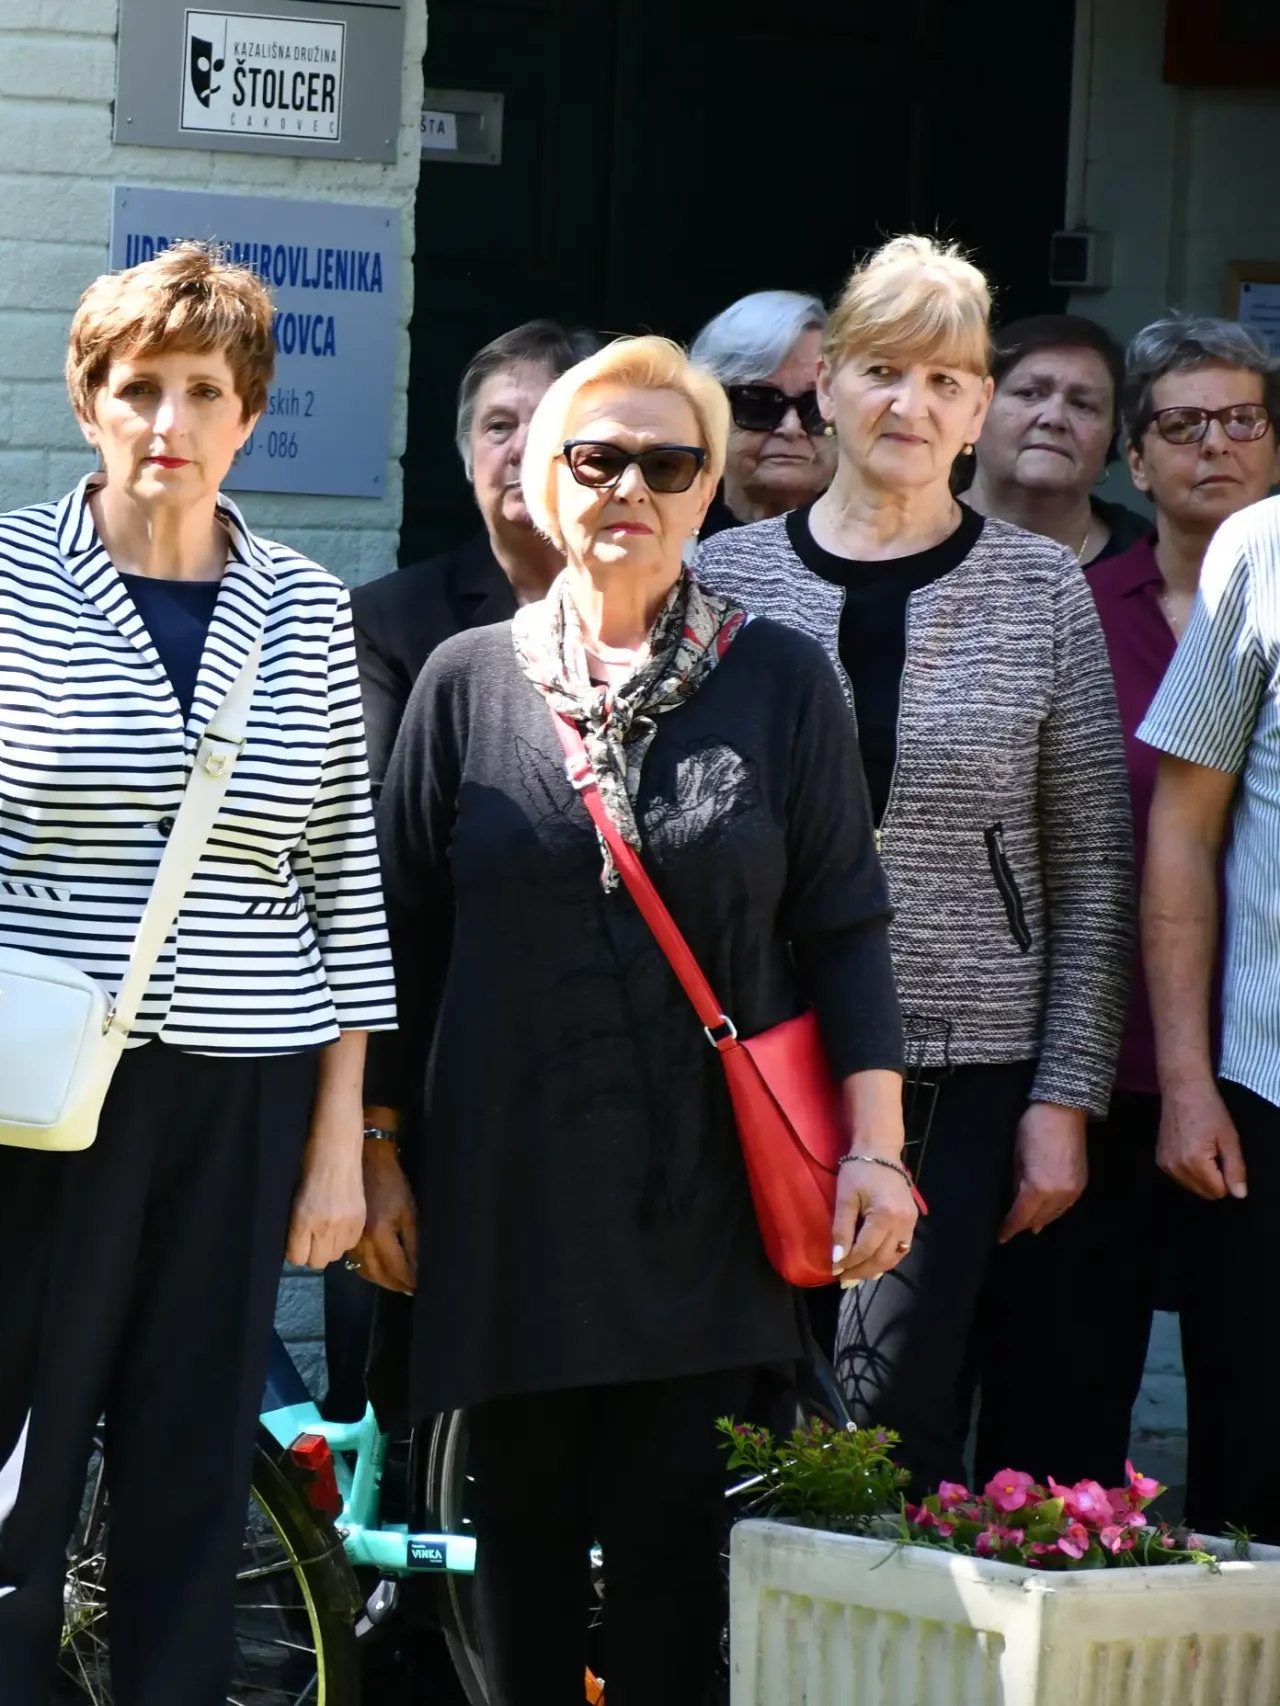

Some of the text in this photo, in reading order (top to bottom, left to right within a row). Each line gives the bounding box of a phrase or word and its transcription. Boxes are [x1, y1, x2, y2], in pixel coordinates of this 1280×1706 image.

[233, 41, 337, 64] KAZALIŠNA DRUŽINA
[232, 58, 336, 113] ŠTOLCER
[230, 112, 335, 133] ČAKOVEC
[421, 115, 446, 134] ŠTA
[272, 312, 336, 357] KOVCA
[268, 387, 315, 417] skih 2
[243, 432, 254, 456] 0
[267, 430, 299, 459] 086
[411, 1549, 442, 1560] VINKA
